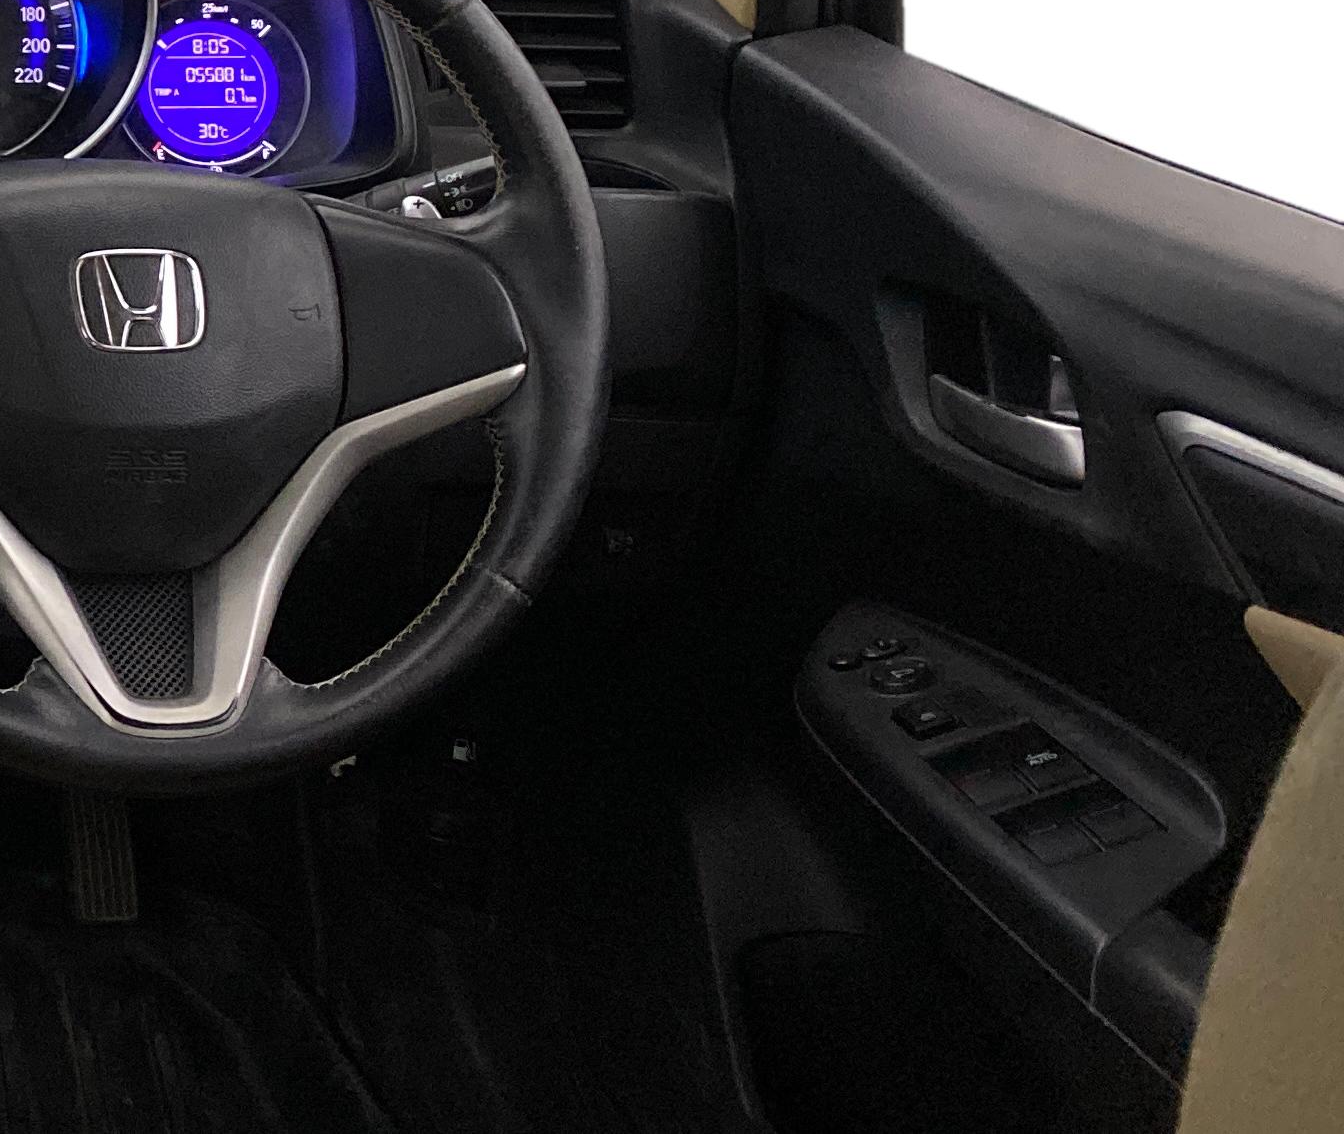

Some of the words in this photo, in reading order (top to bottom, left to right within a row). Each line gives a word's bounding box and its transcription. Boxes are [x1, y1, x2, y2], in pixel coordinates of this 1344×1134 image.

[20, 6, 46, 22] 180
[250, 19, 264, 30] 50
[21, 37, 51, 54] 200
[192, 38, 230, 55] 8:05
[14, 67, 43, 84] 220
[156, 148, 166, 161] E
[262, 148, 271, 160] F
